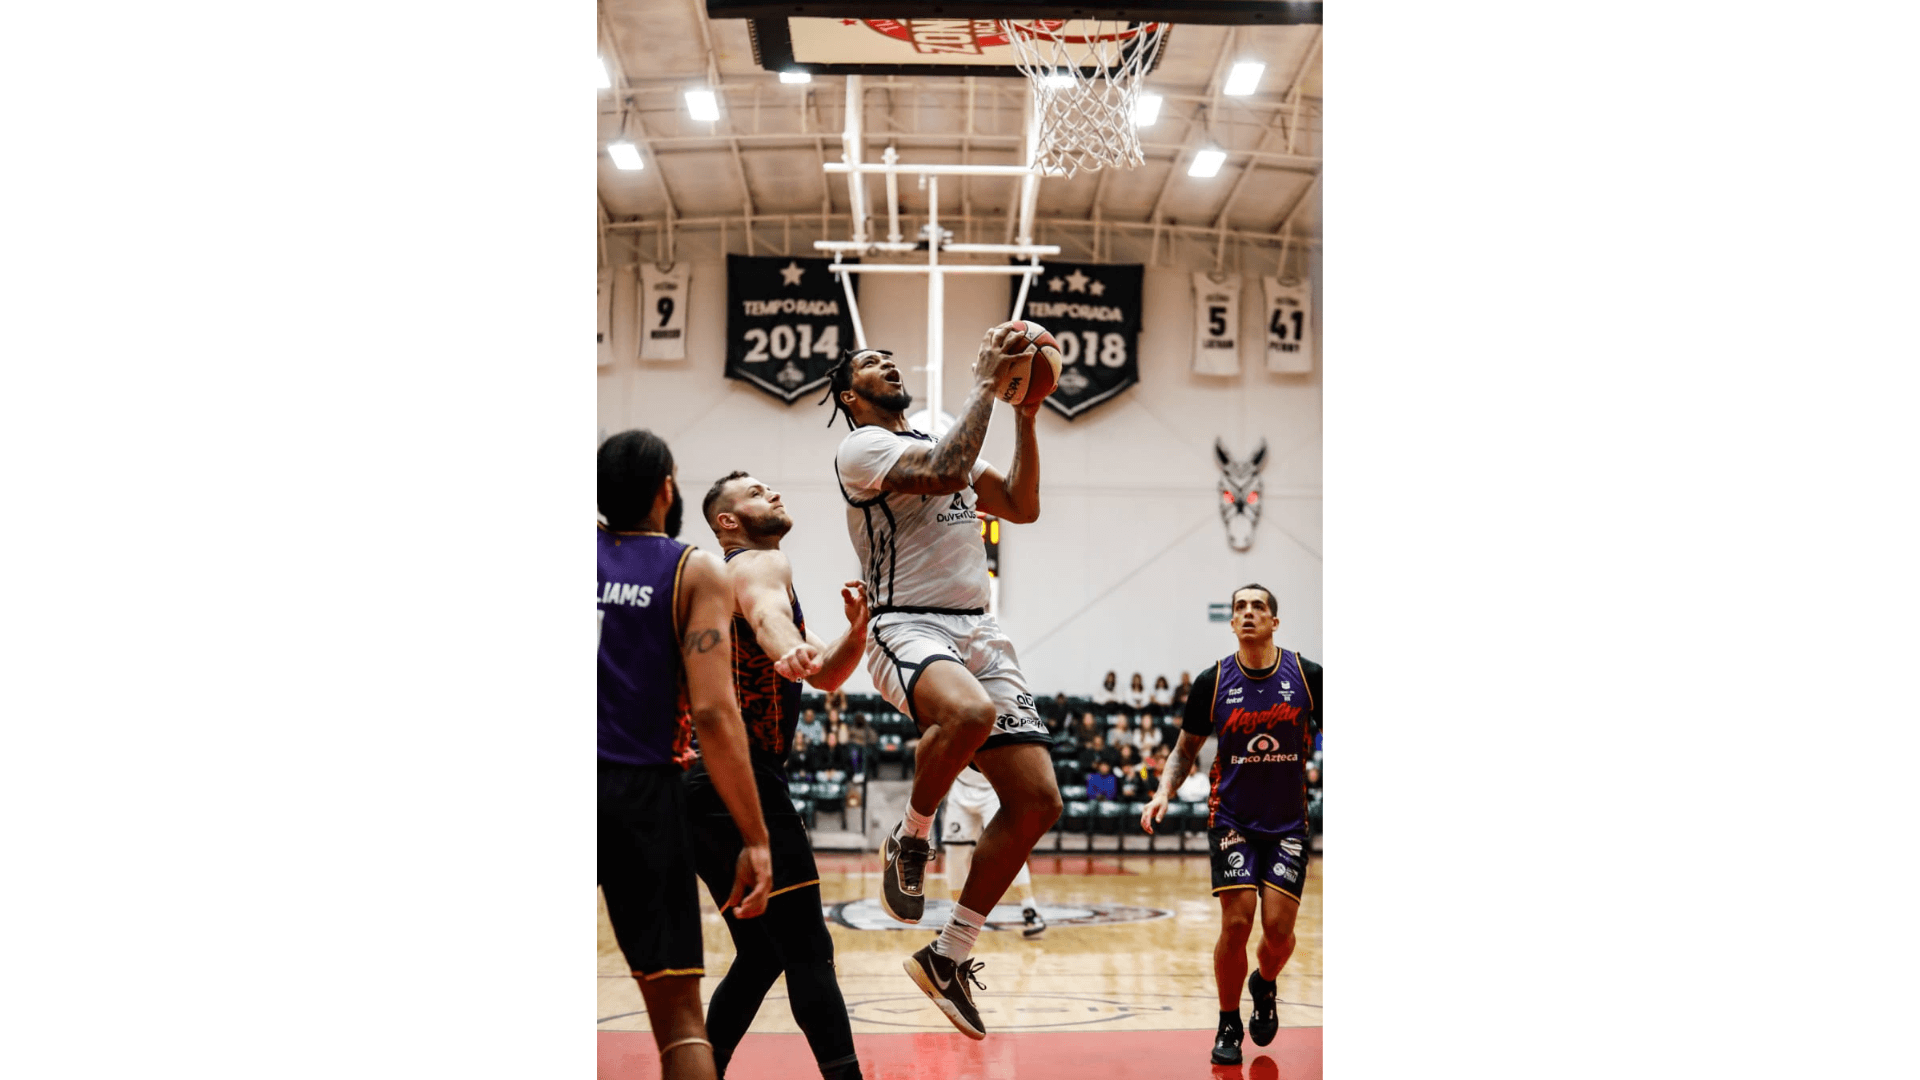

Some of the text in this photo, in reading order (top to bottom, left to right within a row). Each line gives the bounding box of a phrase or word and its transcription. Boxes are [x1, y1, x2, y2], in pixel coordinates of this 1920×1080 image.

[656, 296, 675, 328] 9
[743, 299, 840, 316] TEMPORADA
[1027, 301, 1124, 322] TEMPORADA
[1208, 305, 1227, 337] 5
[1269, 308, 1304, 341] 41
[743, 324, 840, 362] 2014
[1057, 330, 1127, 368] 018
[1231, 753, 1298, 765] Banco Azteca
[1223, 868, 1251, 879] MEGA
